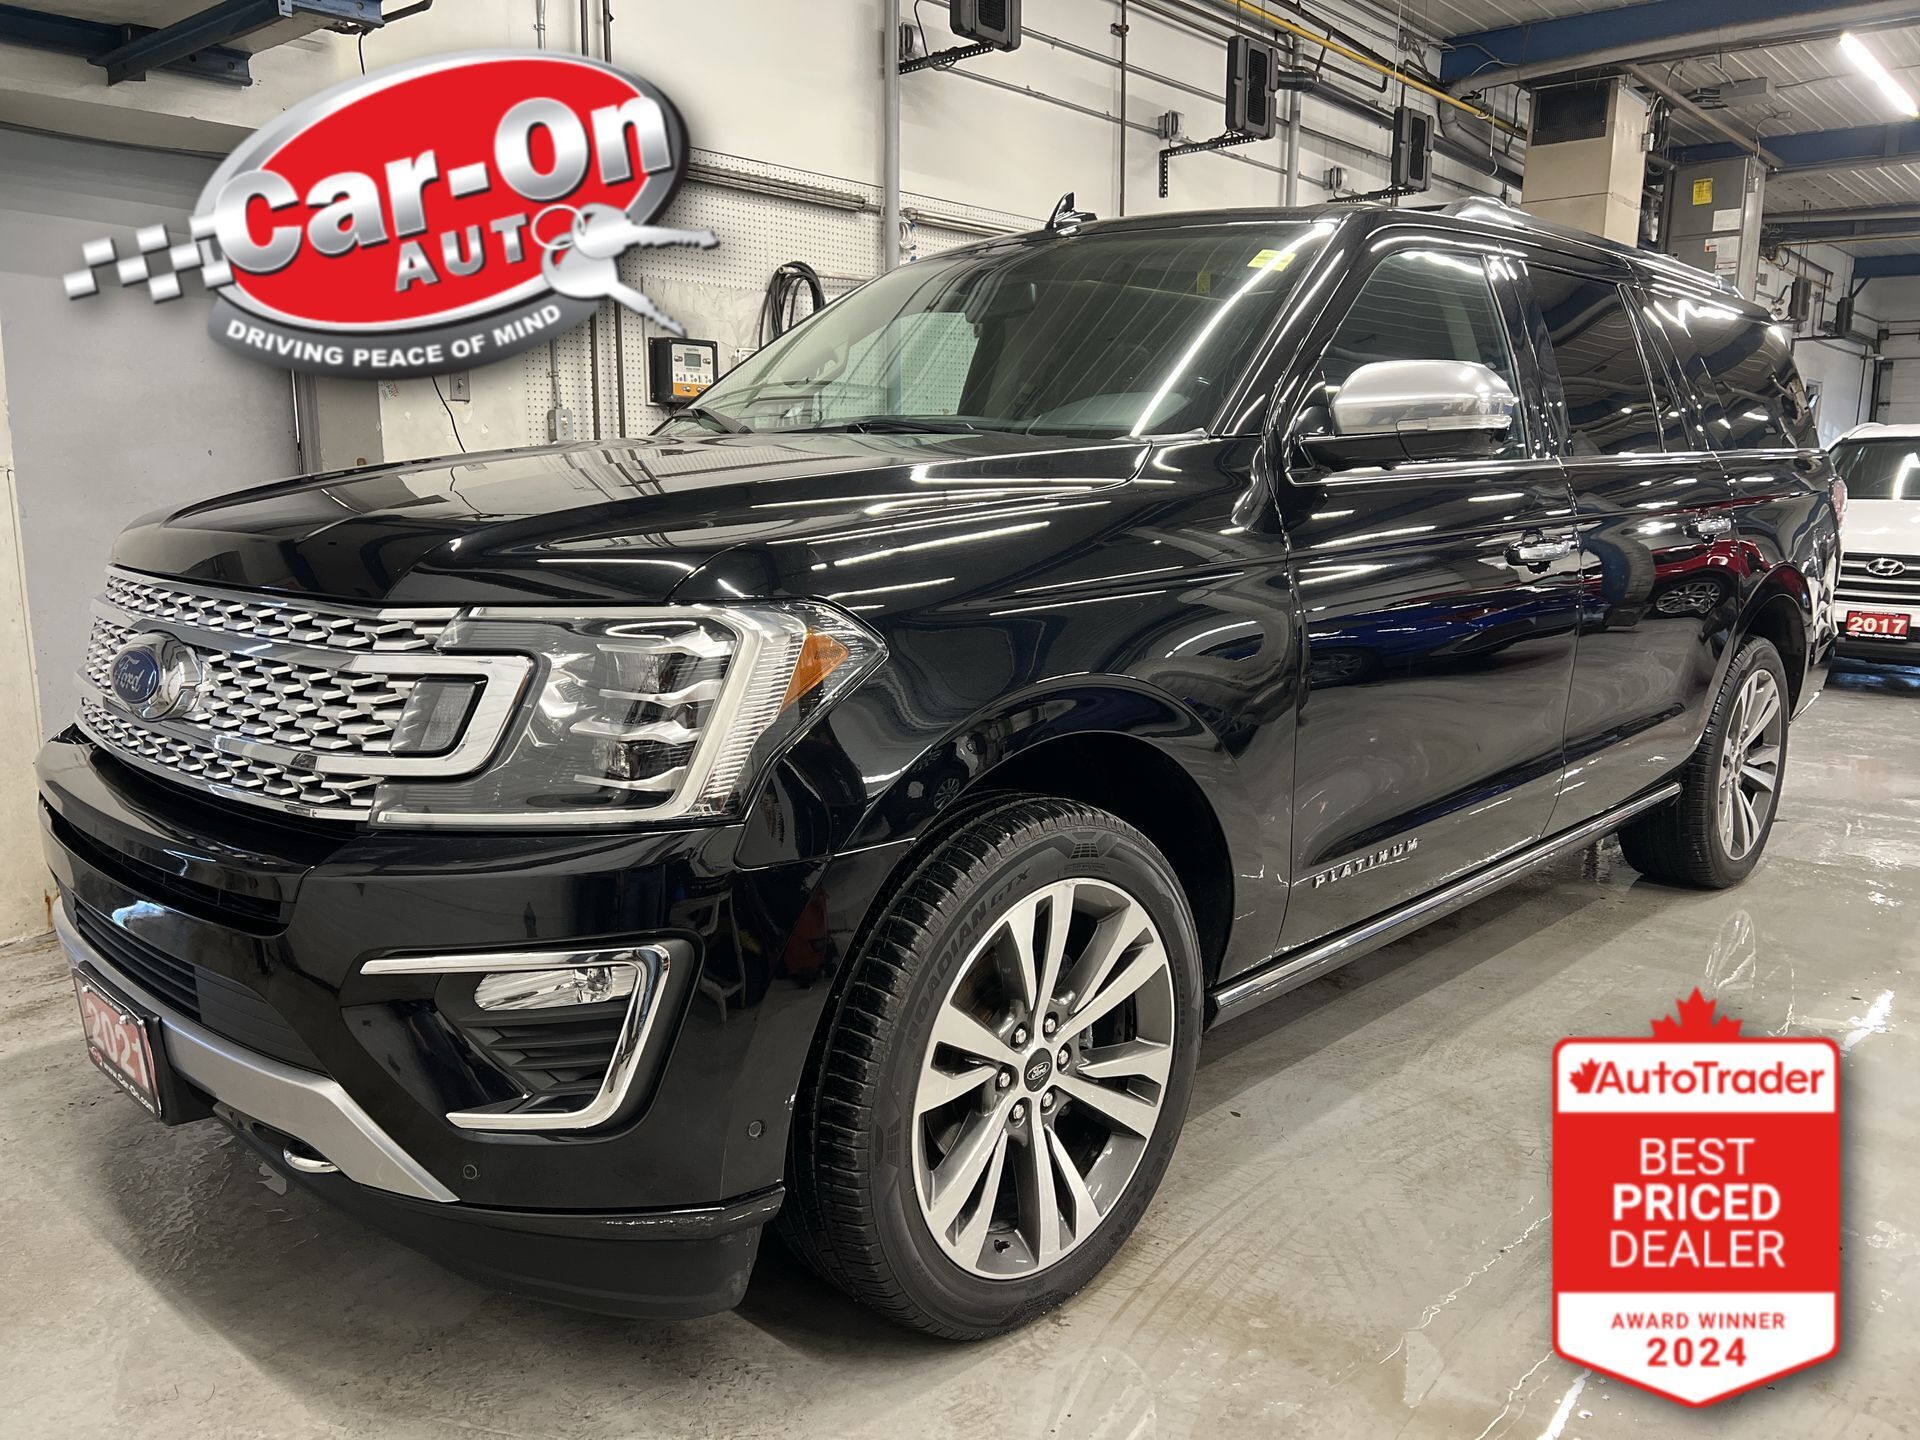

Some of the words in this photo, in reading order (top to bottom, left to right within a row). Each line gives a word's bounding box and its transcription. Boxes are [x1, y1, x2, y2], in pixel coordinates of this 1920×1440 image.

[1848, 616, 1907, 635] 2017
[1313, 838, 1418, 889] PLATINUM
[86, 994, 149, 1091] 2021
